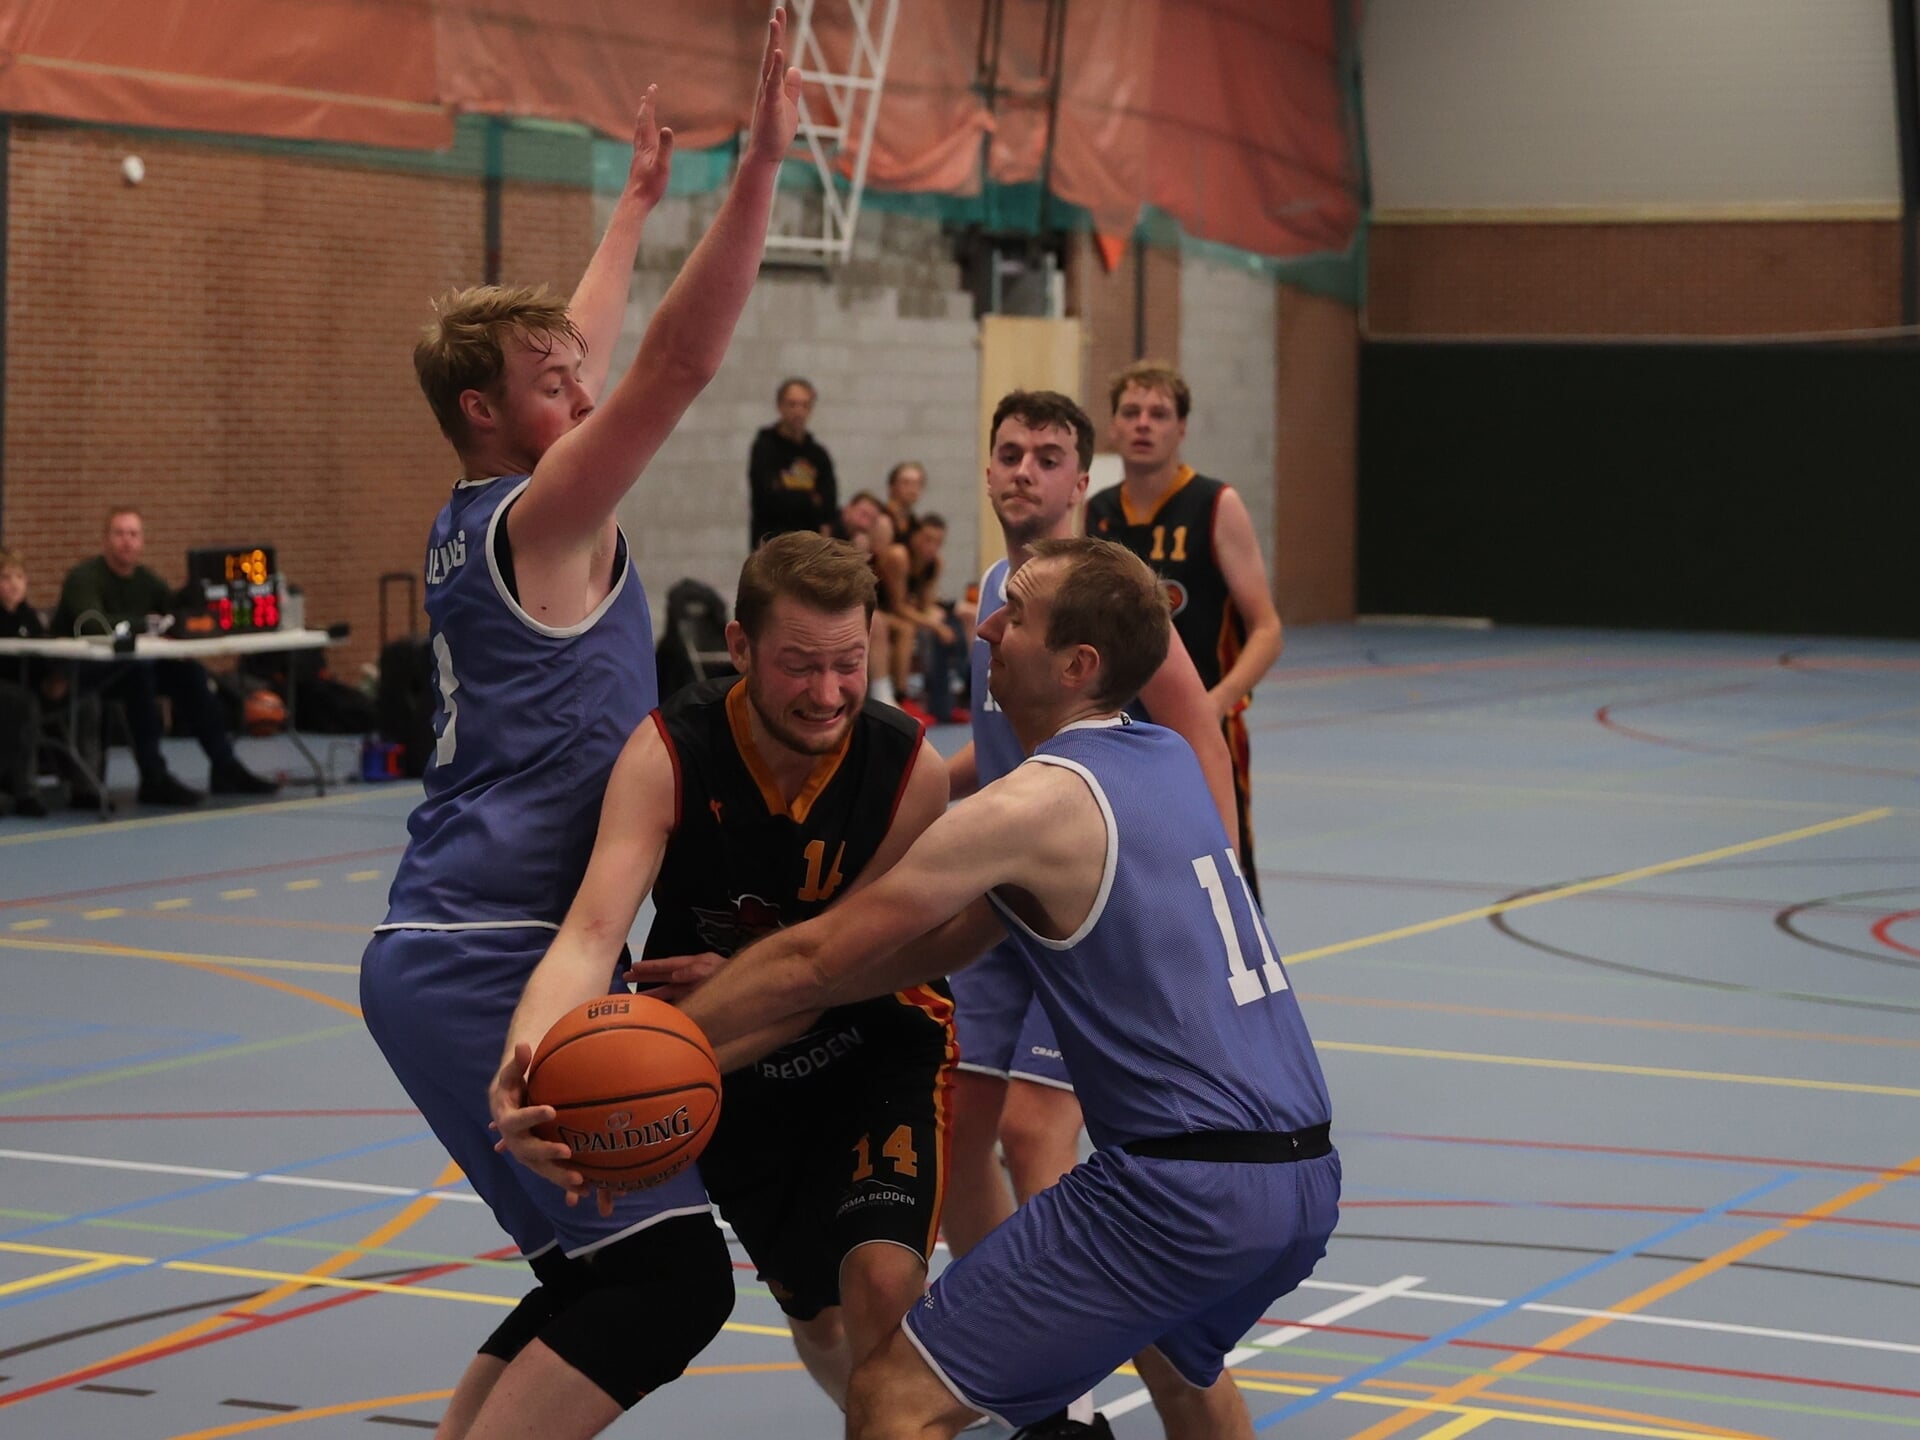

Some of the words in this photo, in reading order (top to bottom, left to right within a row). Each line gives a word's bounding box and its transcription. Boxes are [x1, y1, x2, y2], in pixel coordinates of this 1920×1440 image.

[1151, 525, 1187, 561] 11
[1191, 848, 1289, 1007] 11
[588, 1003, 630, 1019] FIBA
[1031, 1046, 1064, 1061] CRAF
[852, 1125, 918, 1182] 14
